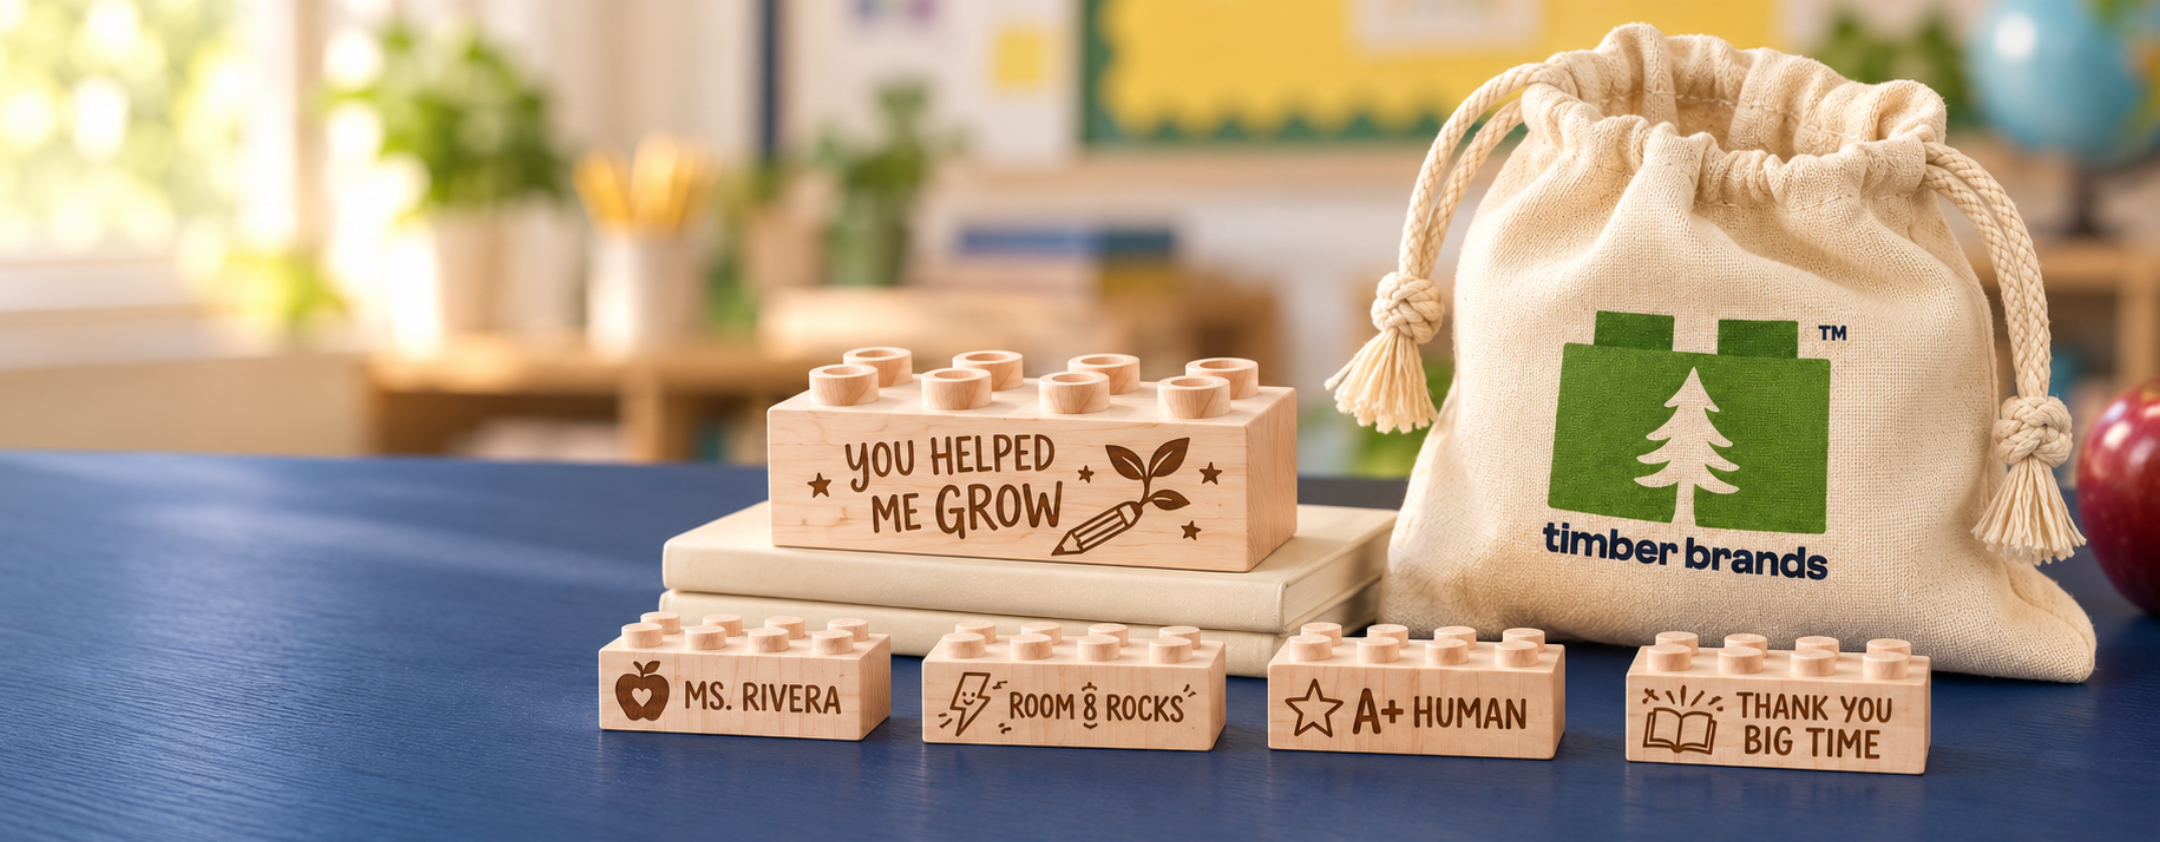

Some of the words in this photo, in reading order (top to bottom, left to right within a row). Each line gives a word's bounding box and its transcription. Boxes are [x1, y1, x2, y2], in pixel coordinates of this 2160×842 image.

[1818, 325, 1847, 341] TM
[844, 440, 914, 493] YOU
[931, 434, 1055, 475] HELPED
[872, 493, 921, 533] ME
[935, 481, 1063, 539] GROW
[1543, 522, 1678, 565] timber
[1685, 537, 1828, 580] brands
[684, 681, 732, 710] MS.
[743, 682, 842, 715] RIVERA
[1009, 691, 1075, 720] ROOM
[1083, 693, 1098, 721] 8
[1107, 694, 1184, 722] ROCKS
[1352, 688, 1404, 734] A+
[1413, 696, 1527, 730] HUMAN
[1736, 692, 1829, 720] THANK
[1840, 696, 1893, 723] YOU
[1744, 725, 1793, 756] BIG
[1806, 728, 1881, 759] TIME
